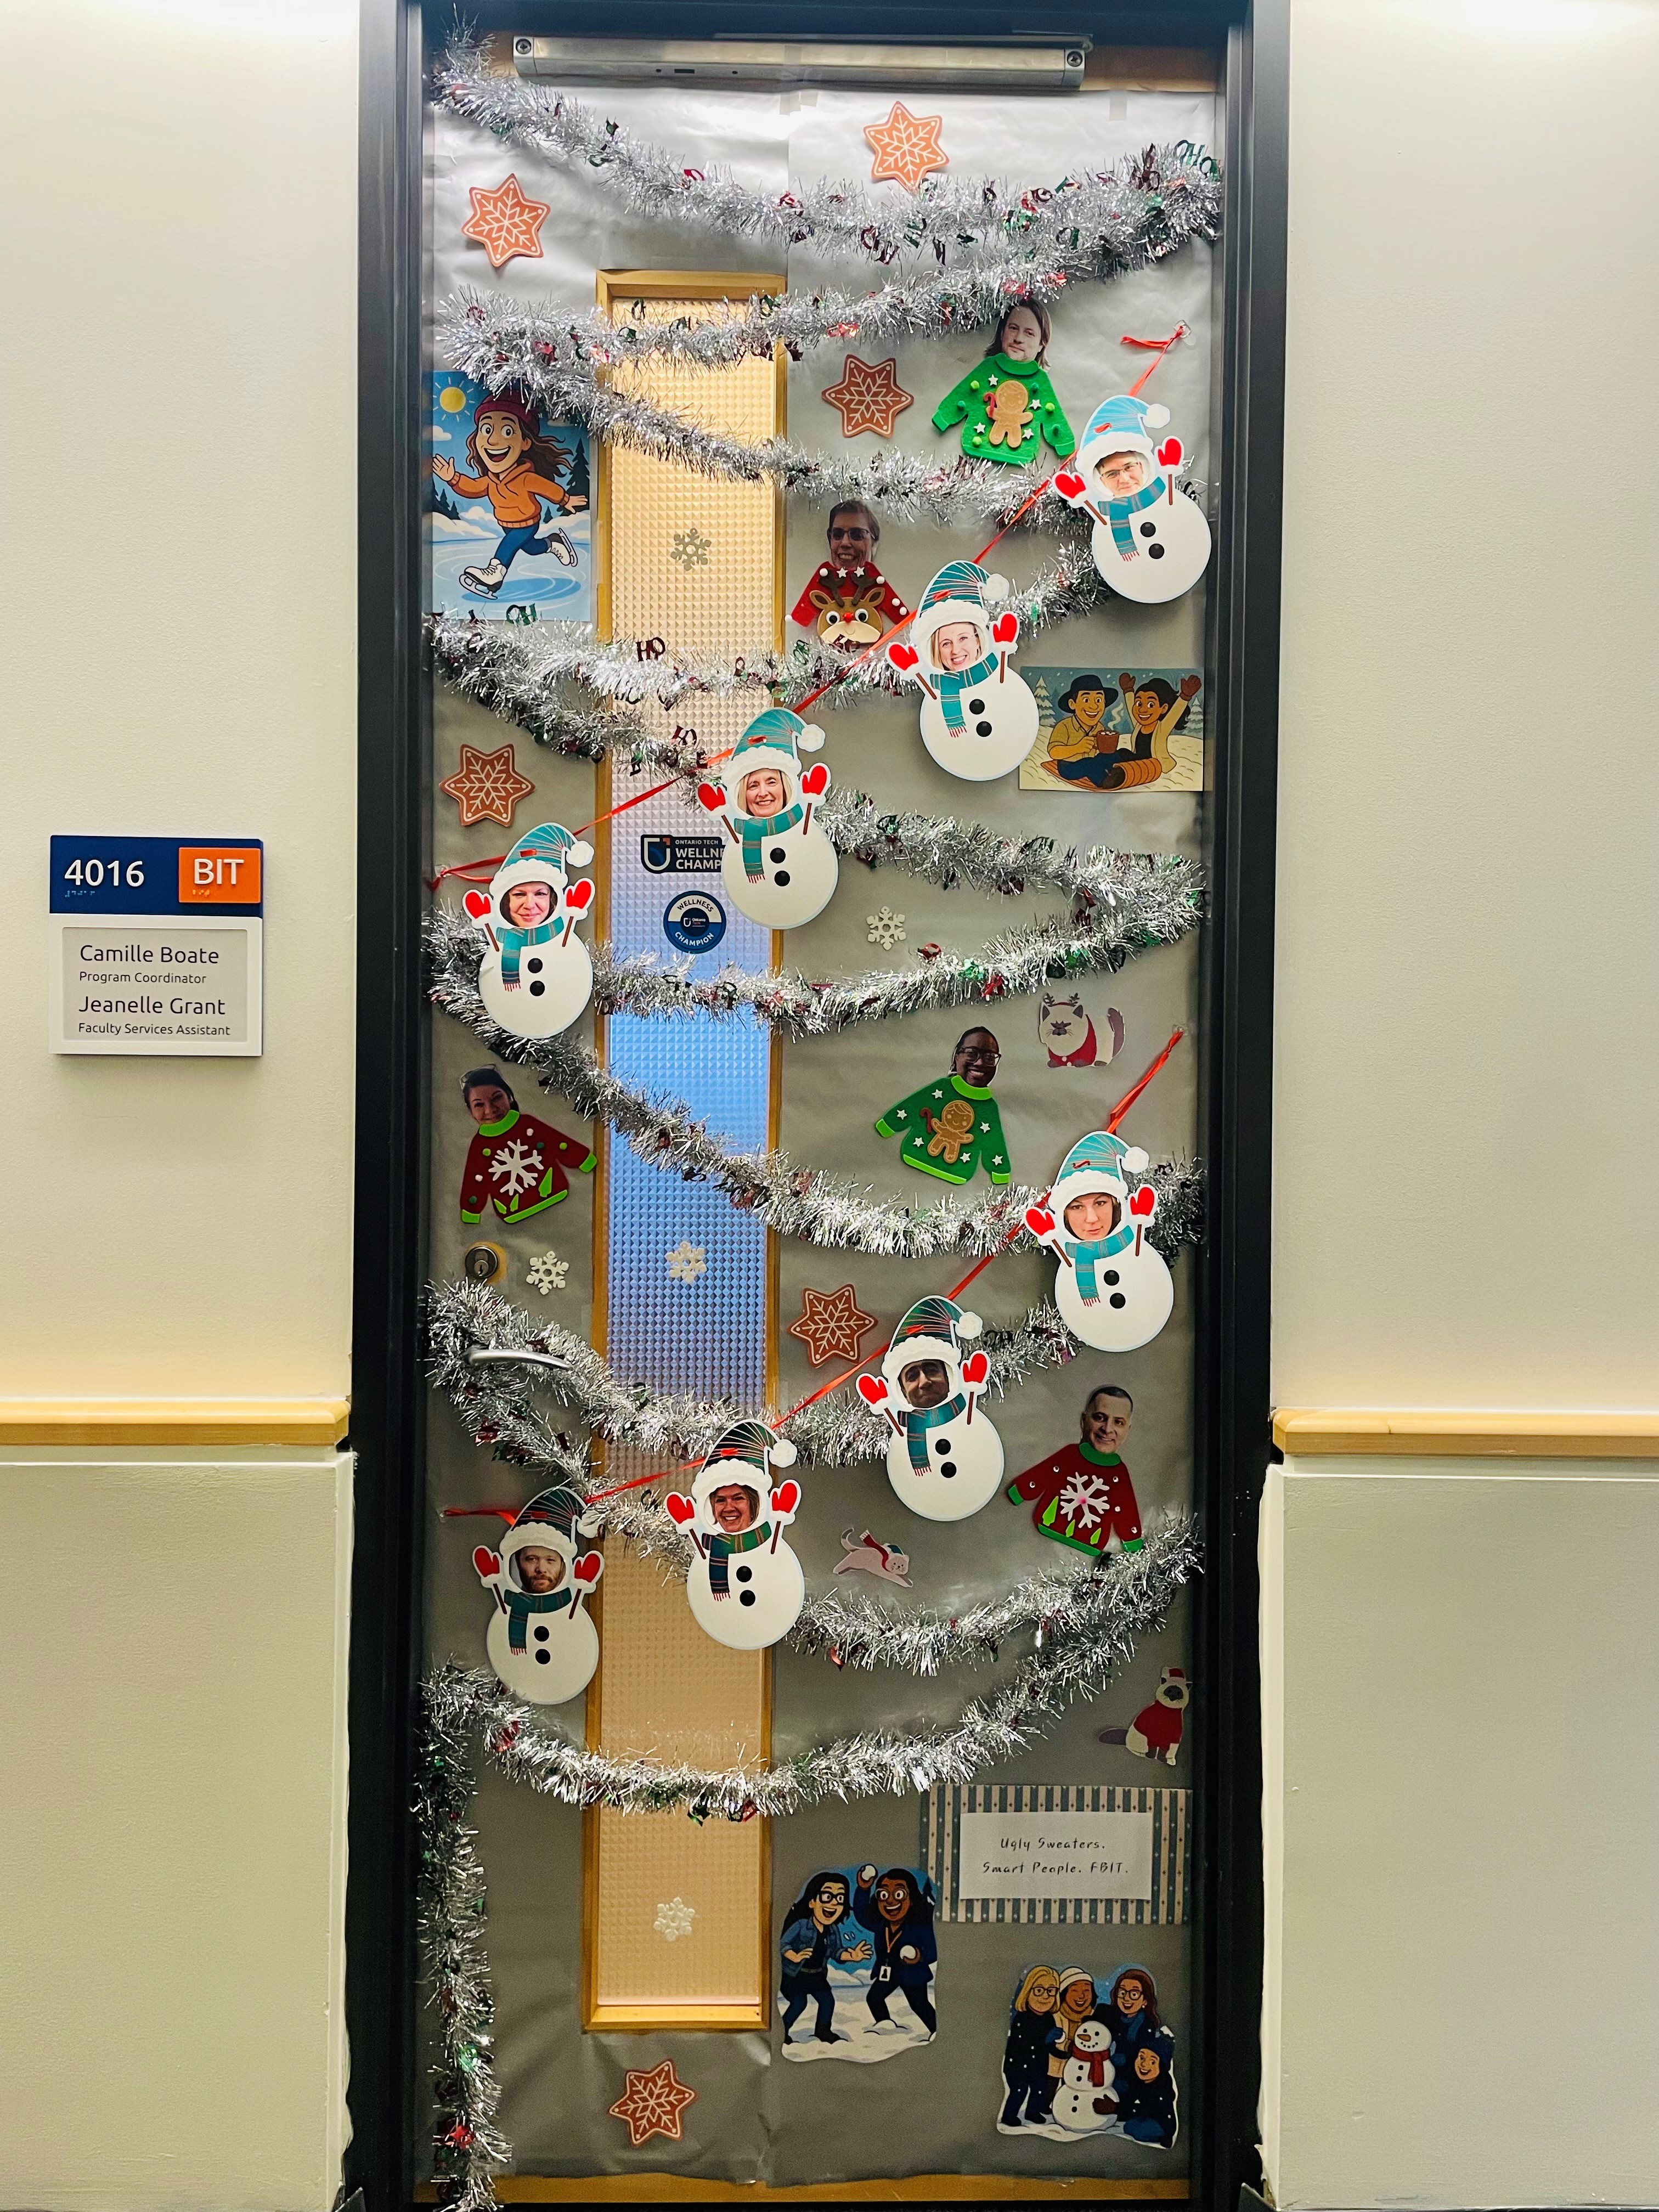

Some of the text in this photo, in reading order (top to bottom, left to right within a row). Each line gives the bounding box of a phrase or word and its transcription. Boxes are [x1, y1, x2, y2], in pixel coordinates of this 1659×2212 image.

[636, 637, 665, 662] HO
[194, 858, 244, 885] BIT
[676, 860, 721, 869] CHAMP
[64, 859, 144, 887] 4016
[677, 899, 714, 912] WELLNESS
[675, 932, 714, 946] CHAMPION
[80, 945, 219, 963] Camille Boate
[80, 971, 206, 984] Program Coordinator
[79, 996, 225, 1015] Jeanelle Grant
[79, 1023, 230, 1035] Faculty Services Assistant
[1001, 1837, 1105, 1851] Ugly Sweaters.
[983, 1862, 1128, 1875] Smart People. FBIT.
